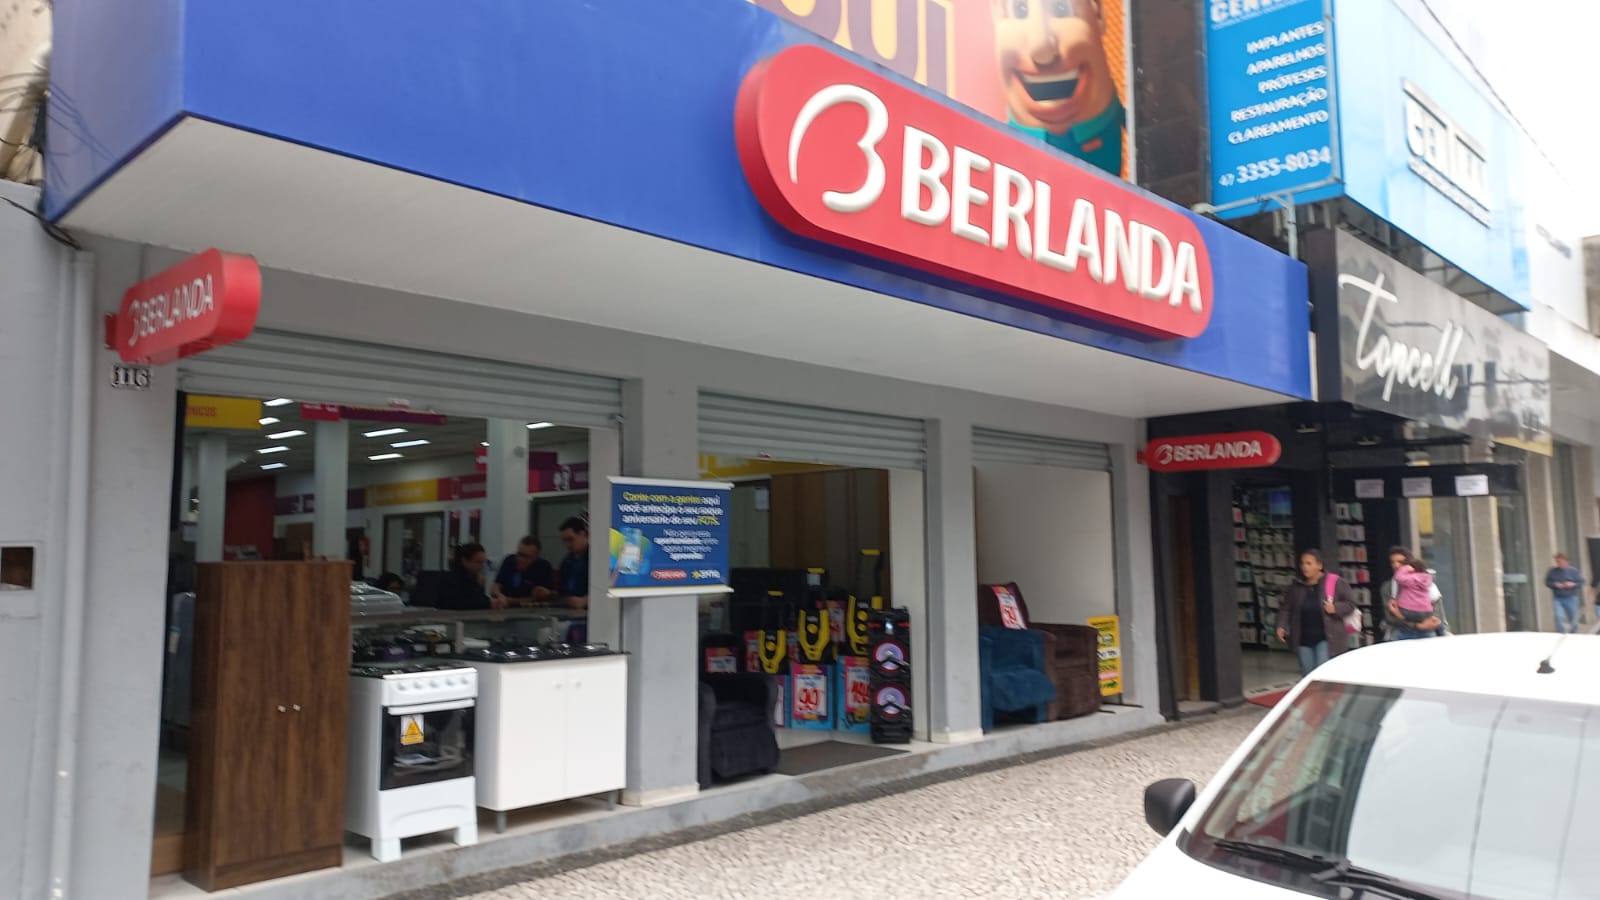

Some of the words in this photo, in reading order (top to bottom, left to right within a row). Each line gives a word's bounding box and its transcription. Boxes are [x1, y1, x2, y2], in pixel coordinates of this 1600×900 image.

[1247, 20, 1326, 54] IMPLANTES
[1247, 43, 1327, 75] APARELHOS
[1258, 65, 1327, 93] PRÓTESES
[1231, 86, 1328, 122] RESTAURAÇÃO
[1228, 110, 1329, 144] CLAREAMENTO
[1218, 173, 1235, 187] 47
[1236, 145, 1332, 184] 3355-8034
[901, 124, 1203, 313] BERLANDA
[139, 272, 214, 338] BERLANDA
[1174, 440, 1263, 462] BERLANDA
